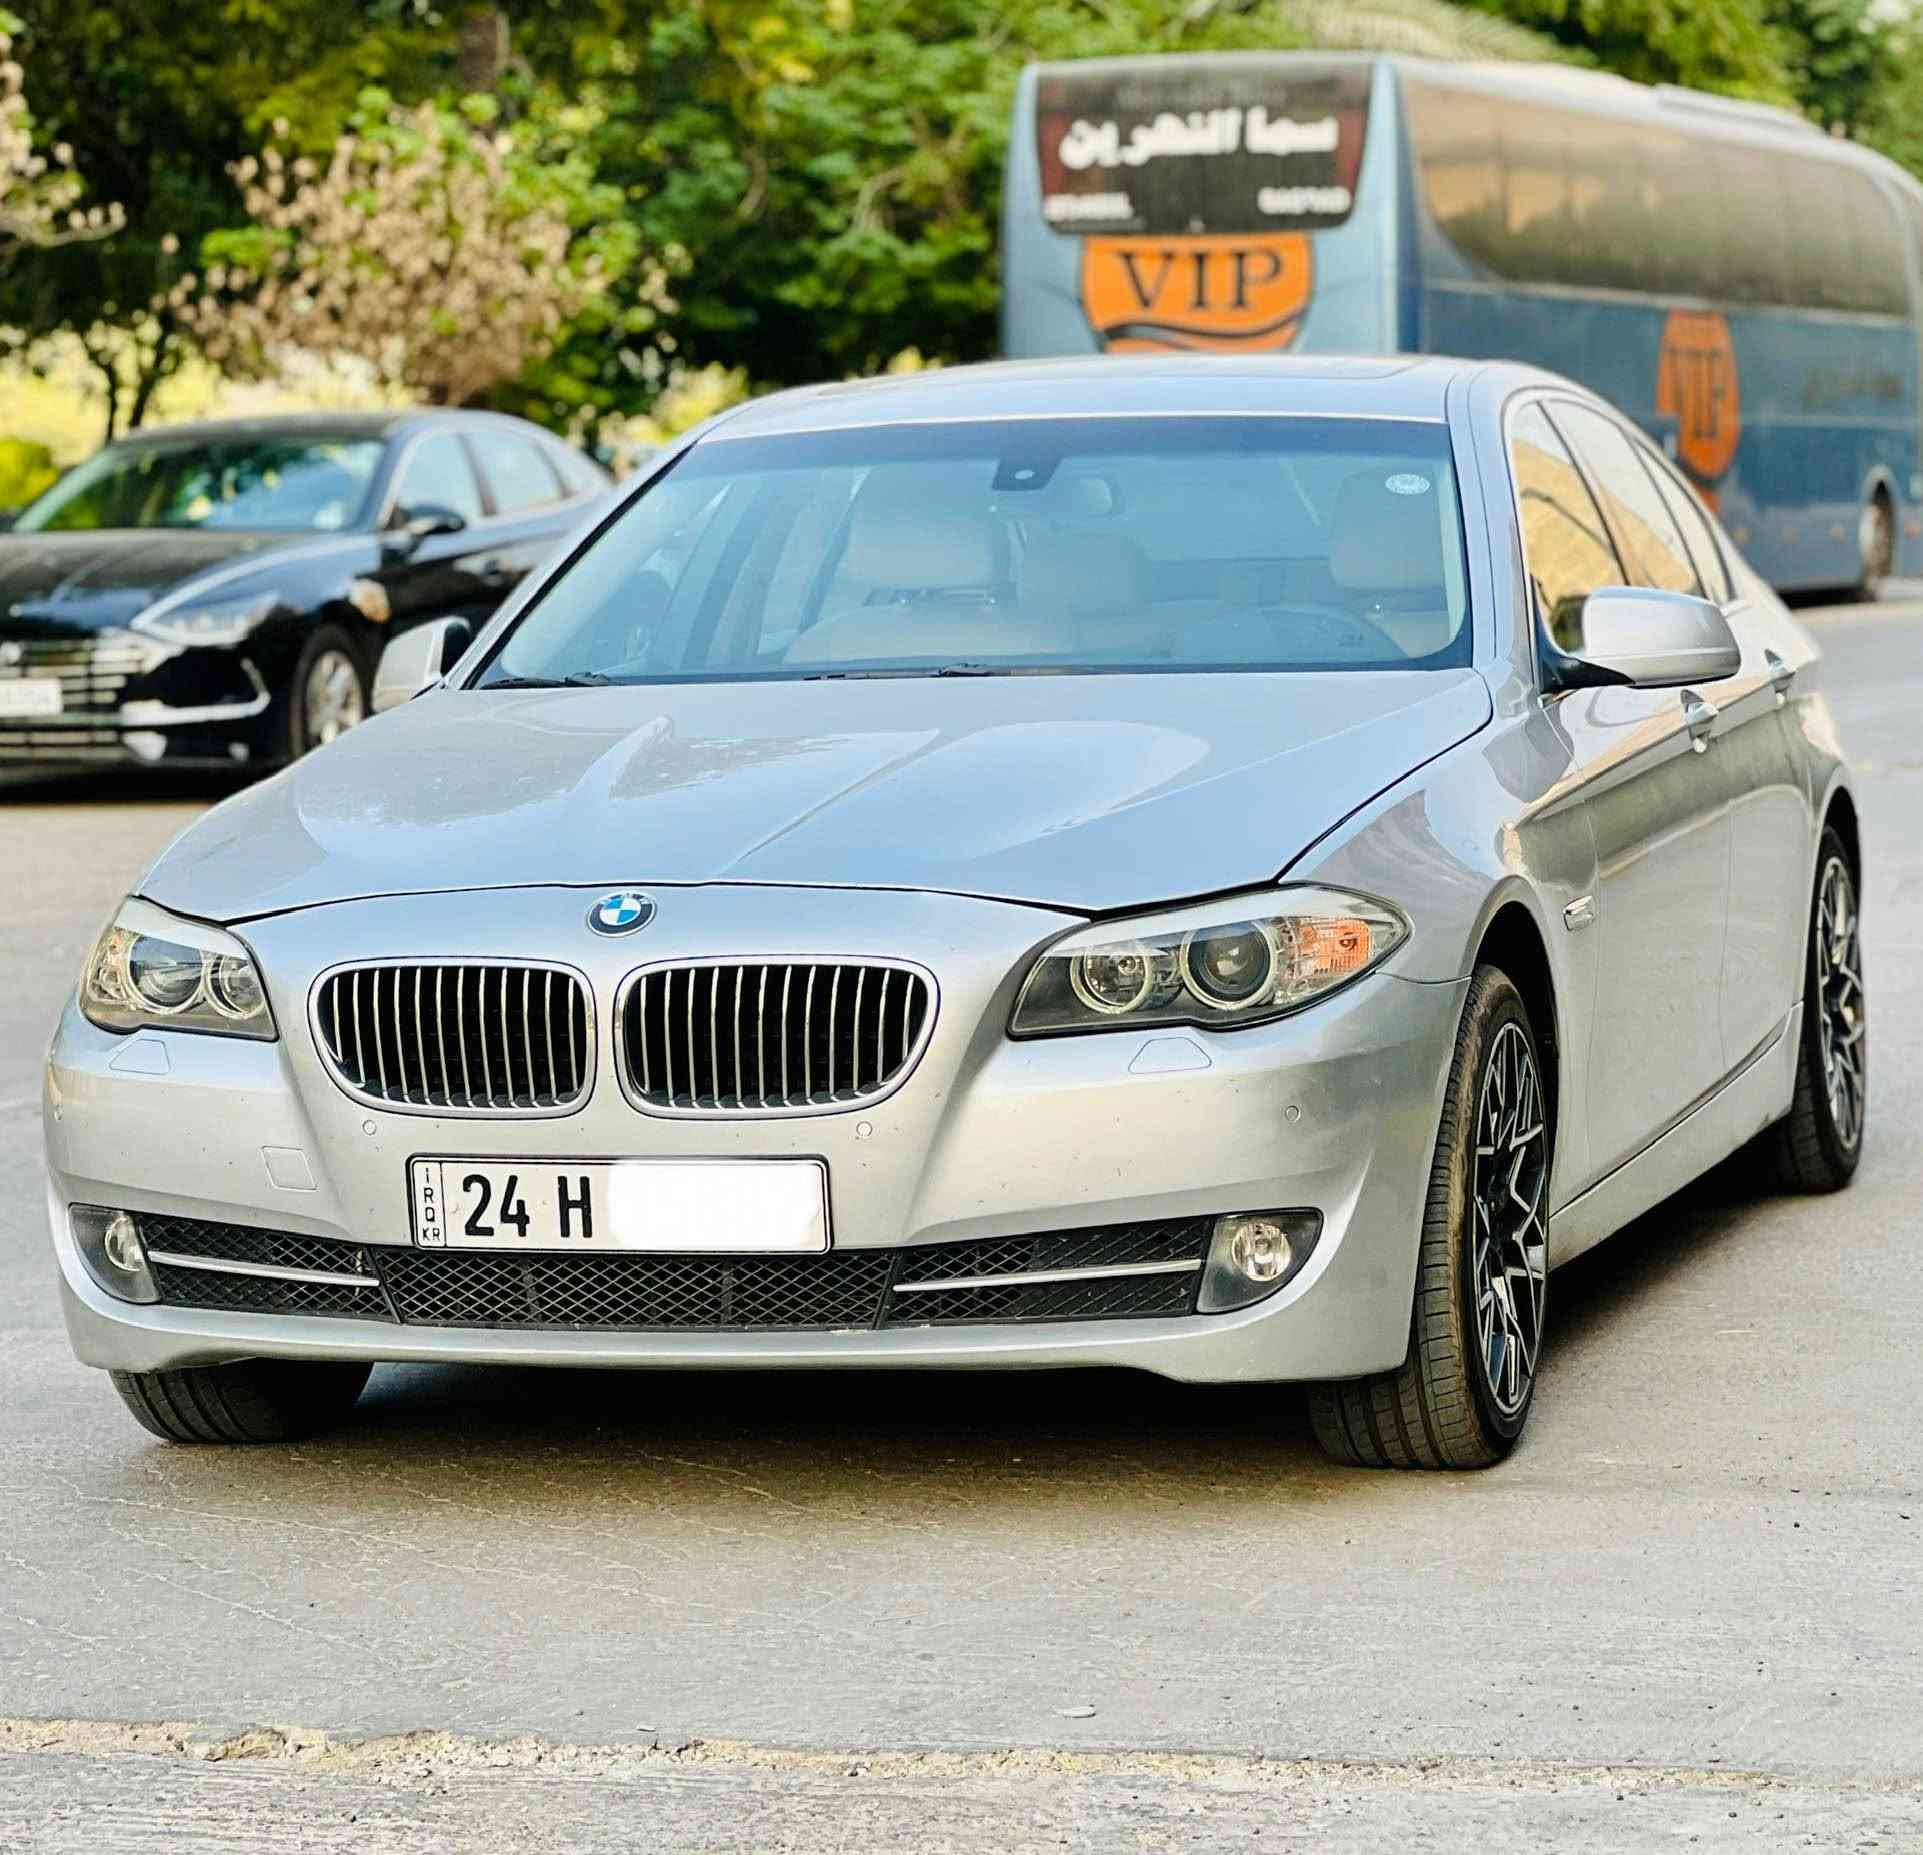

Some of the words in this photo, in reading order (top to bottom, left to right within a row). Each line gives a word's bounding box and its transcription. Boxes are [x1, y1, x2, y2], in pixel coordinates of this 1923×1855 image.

[1118, 249, 1282, 309] VIP
[422, 1228, 441, 1241] KR
[463, 1174, 530, 1238] 24
[558, 1175, 593, 1238] H
